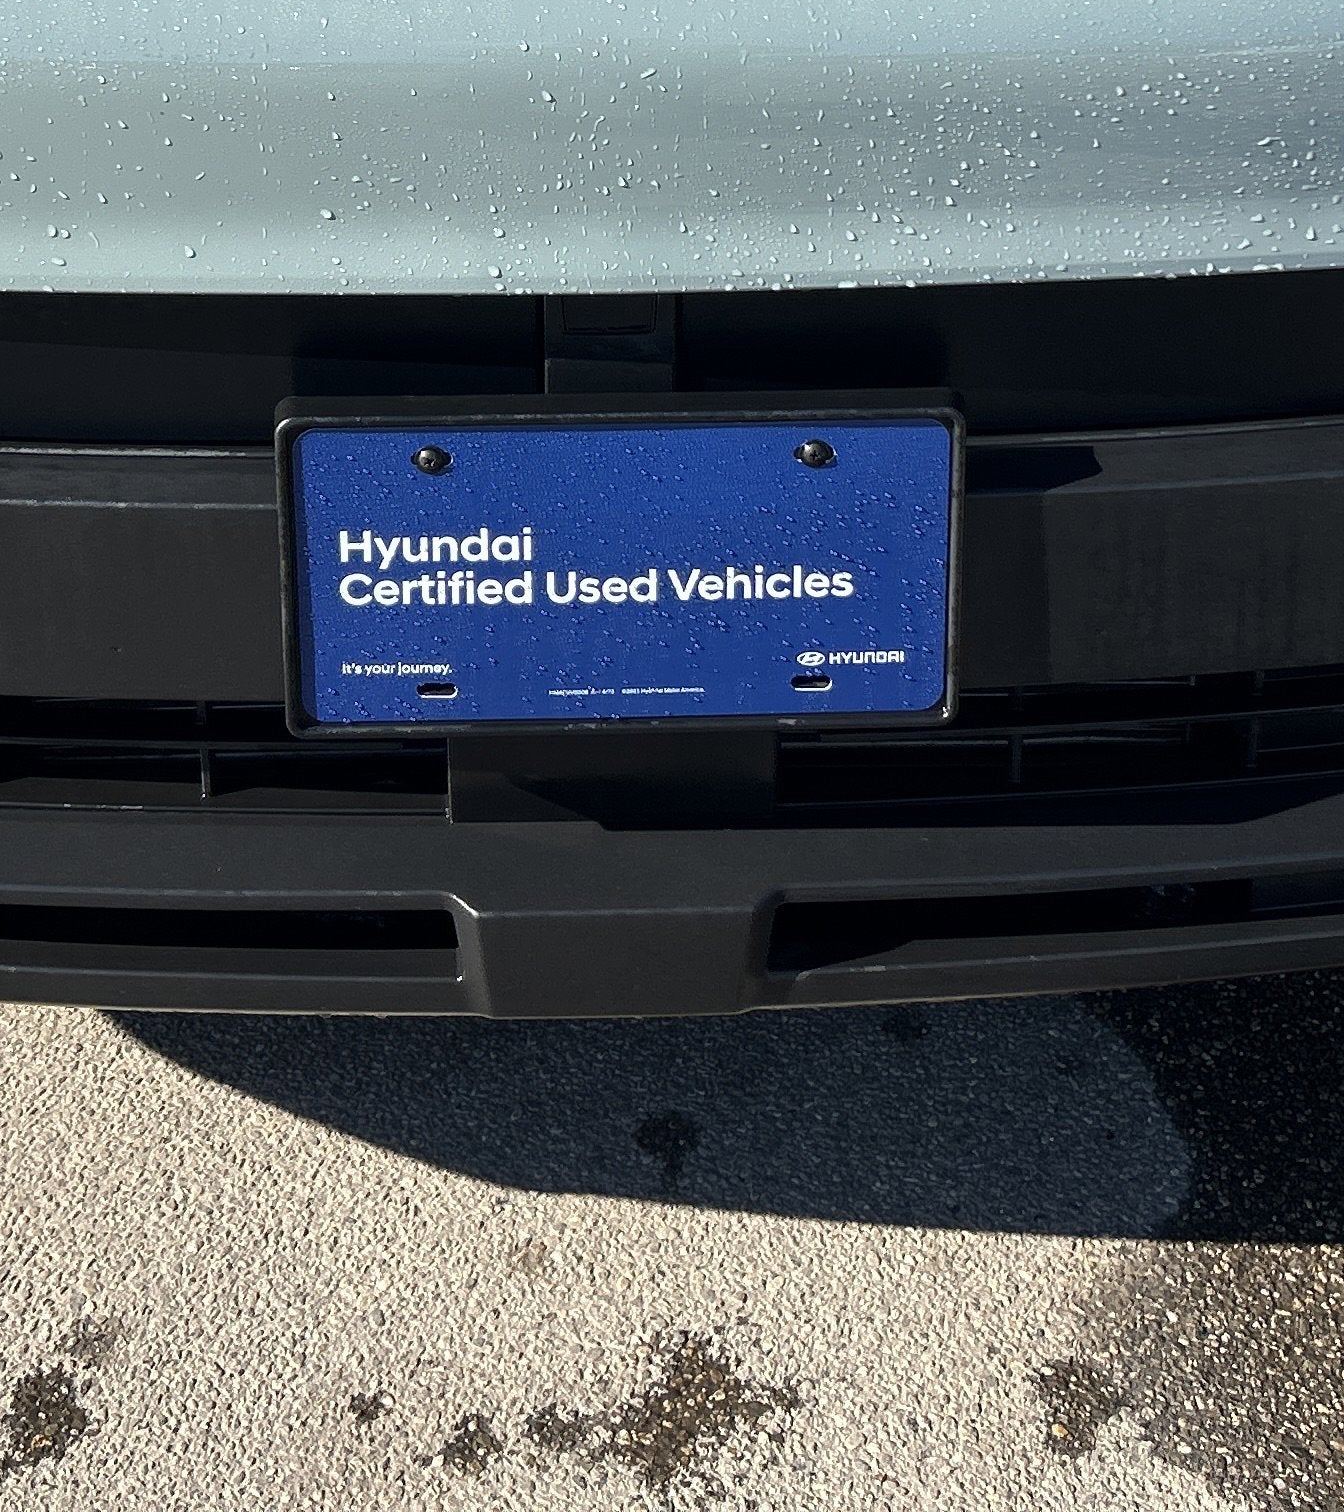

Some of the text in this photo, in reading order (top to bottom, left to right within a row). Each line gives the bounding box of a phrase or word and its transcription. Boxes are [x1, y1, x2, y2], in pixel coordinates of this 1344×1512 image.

[339, 526, 533, 571] Hyundai
[339, 564, 854, 606] Certified Used Vehicles
[364, 664, 396, 676] your
[829, 651, 905, 664] HYUNDAI
